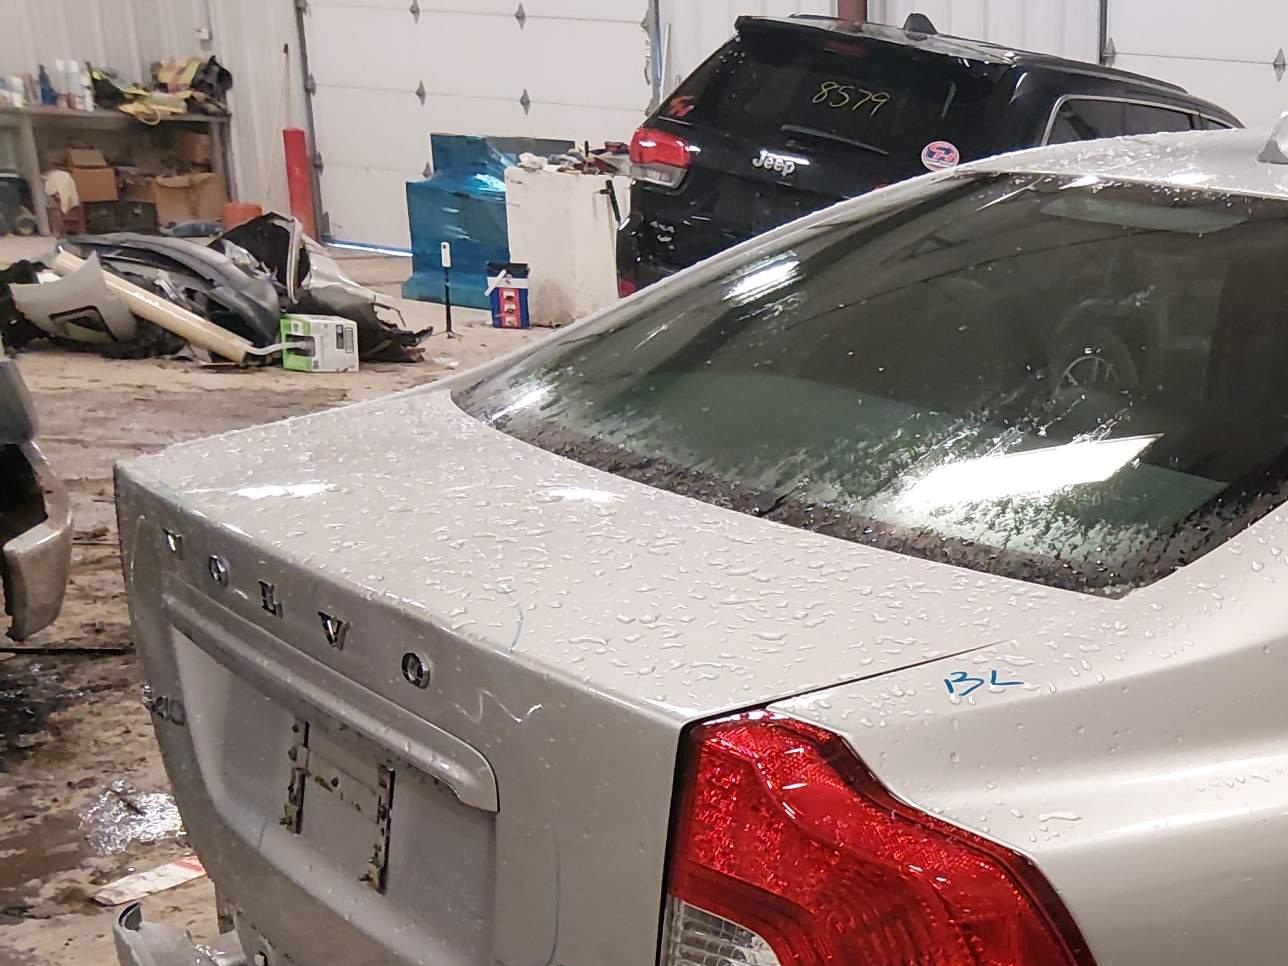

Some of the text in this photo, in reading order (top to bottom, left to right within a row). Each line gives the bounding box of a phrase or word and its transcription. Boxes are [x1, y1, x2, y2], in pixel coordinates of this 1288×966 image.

[811, 81, 891, 117] 8579
[752, 151, 797, 176] Jeep
[163, 527, 430, 689] VOLVO
[943, 669, 1025, 697] BL
